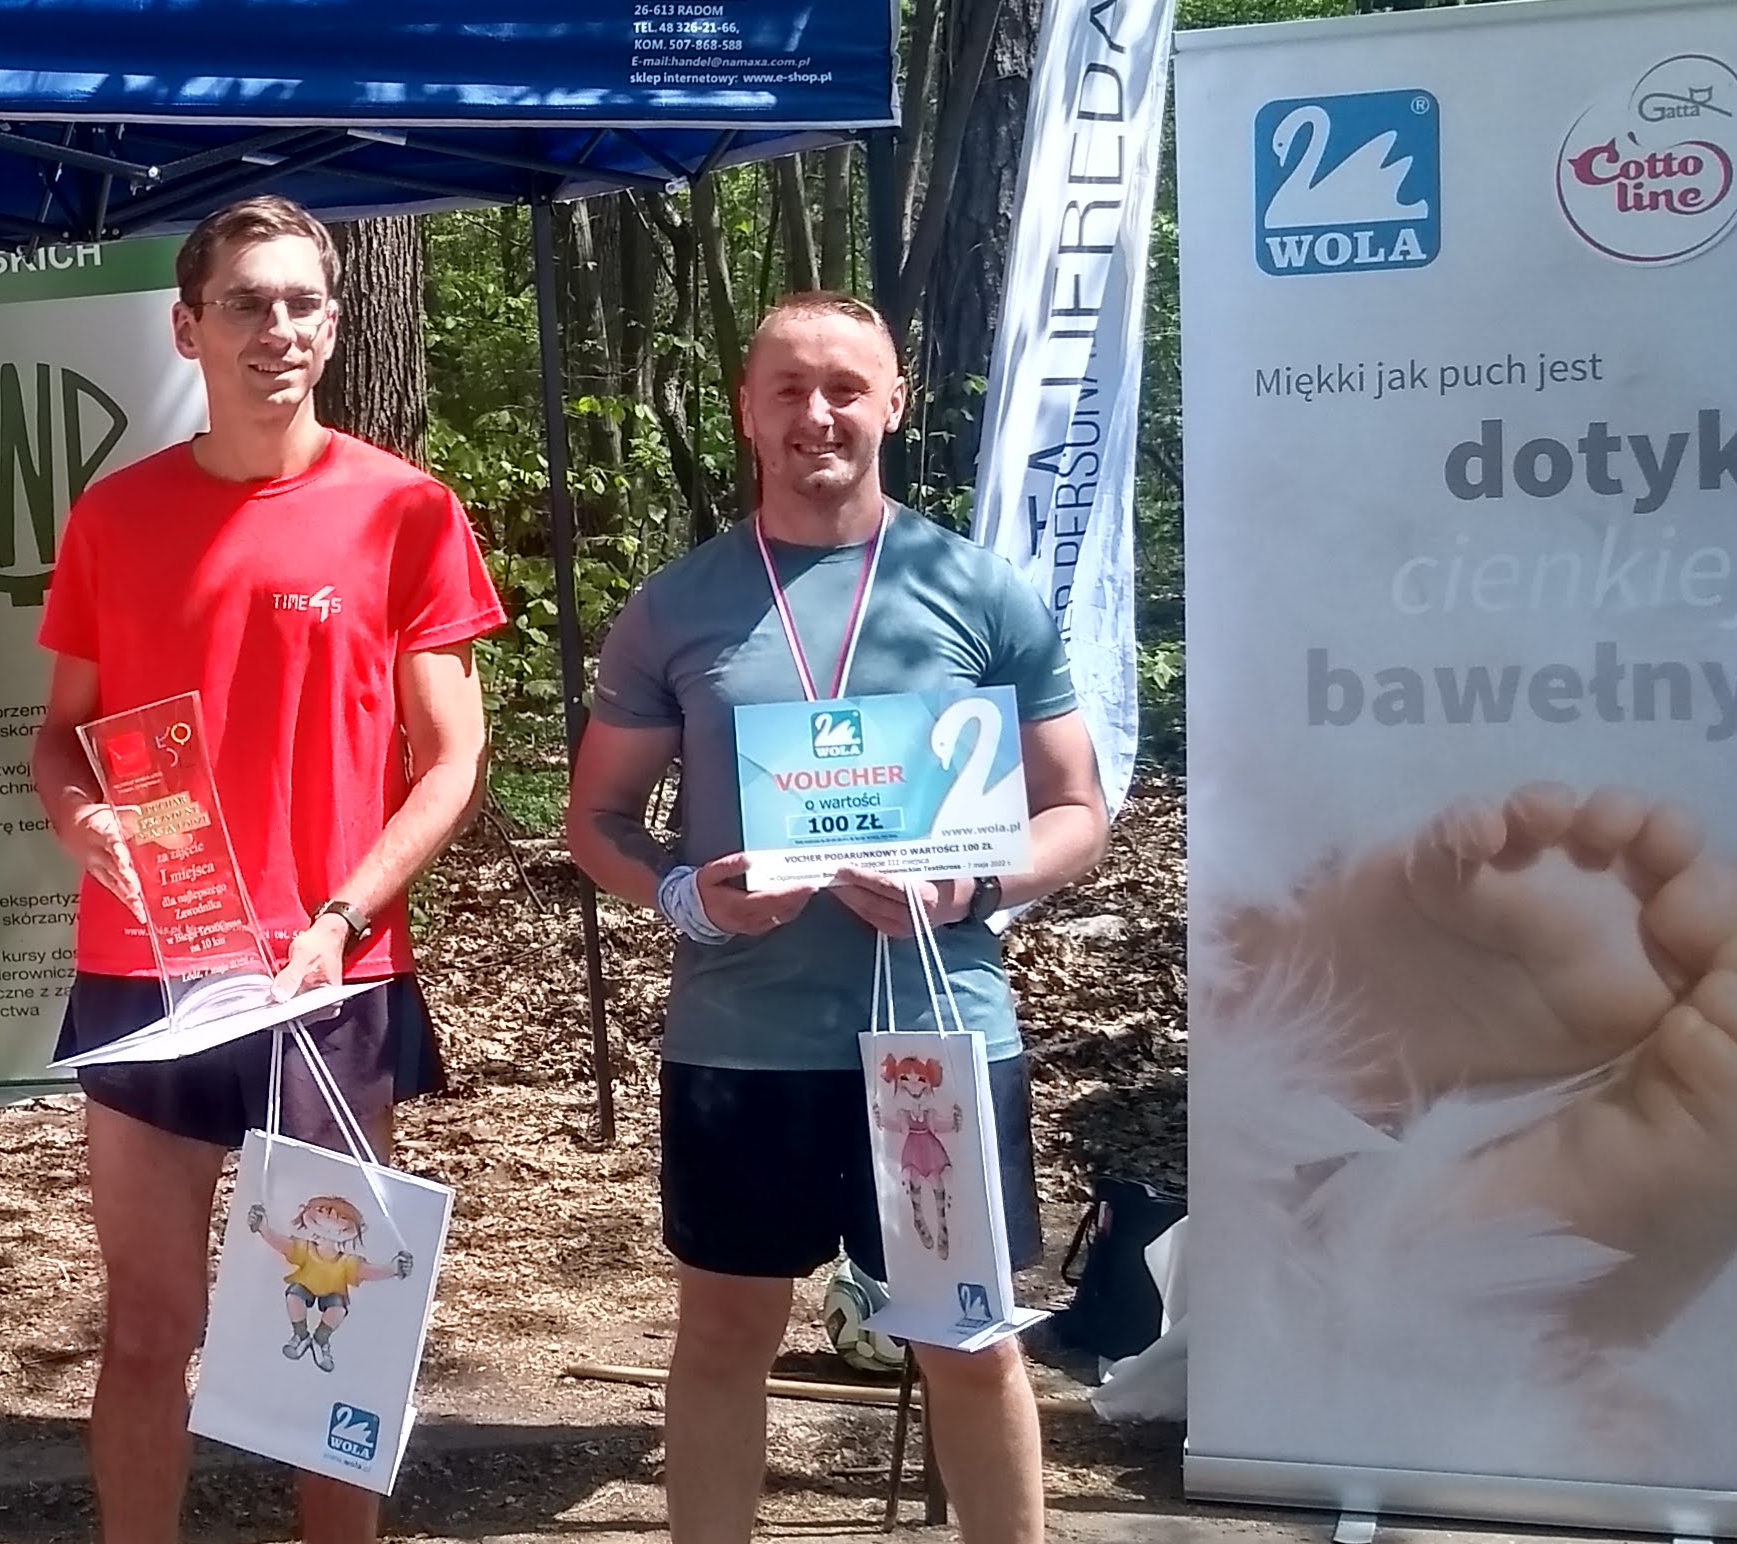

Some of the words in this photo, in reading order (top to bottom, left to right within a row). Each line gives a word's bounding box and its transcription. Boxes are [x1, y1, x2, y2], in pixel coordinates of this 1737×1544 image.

[634, 5, 675, 16] 26-613
[677, 5, 724, 16] RADOM
[633, 22, 657, 33] TEL.
[658, 22, 674, 33] 48
[676, 22, 740, 35] 326-21-66,
[634, 40, 666, 50] KOM.
[668, 39, 743, 51] 507-868-588
[630, 72, 661, 85] sklep
[664, 73, 739, 86] internetowy:
[743, 71, 832, 85] www.e-shop.pl
[1638, 92, 1701, 122] Gatta
[1616, 181, 1705, 215] line
[1265, 227, 1427, 269] WOLA
[1254, 362, 1365, 402] Miękki
[1374, 357, 1429, 400] jak
[1439, 353, 1528, 396] puch
[1534, 351, 1604, 390] jest
[1444, 409, 1737, 515] dotyk
[1392, 522, 1737, 632] cienkie
[1306, 641, 1737, 742] bawełny
[814, 744, 861, 757] WOLA
[774, 764, 906, 792] VOUCHER
[804, 800, 814, 810] o
[819, 792, 881, 810] wartości
[808, 816, 849, 834] 100
[856, 812, 883, 831] ZŁ
[941, 821, 1022, 839] www.wola.pl
[784, 854, 822, 864] VOCHER
[825, 849, 898, 861] PODARUNKOWY
[900, 848, 907, 856] O
[910, 844, 960, 855] WARTOŚCI
[962, 843, 979, 852] 100
[982, 842, 993, 850] ZŁ
[2, 910, 80, 929] skórzany
[2, 949, 46, 965] kursy
[40, 987, 49, 997] z
[331, 1436, 371, 1459] WOLA
